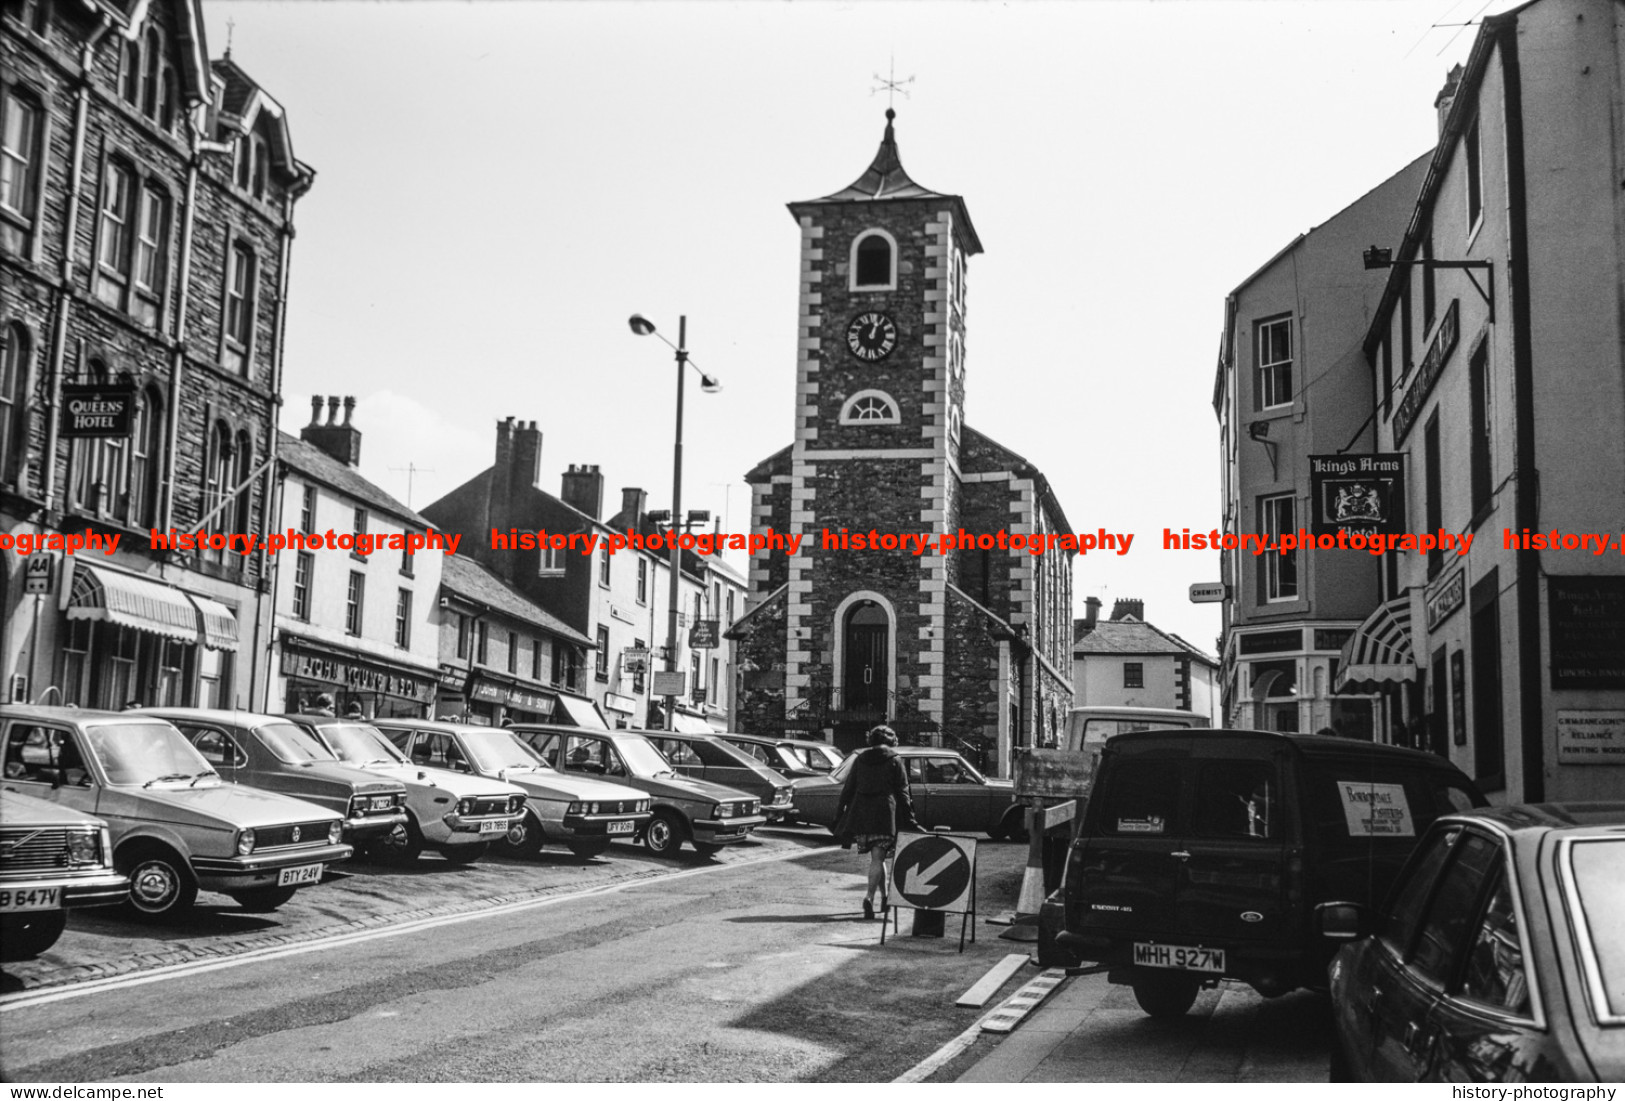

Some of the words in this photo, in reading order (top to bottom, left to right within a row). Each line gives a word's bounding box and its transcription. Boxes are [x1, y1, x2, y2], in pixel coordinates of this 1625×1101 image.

[69, 400, 124, 415] QUEENS
[74, 416, 115, 429] HOTEL
[1360, 458, 1399, 472] Arms
[29, 558, 48, 573] AA
[1192, 588, 1223, 597] CHEMIST
[303, 657, 339, 681] JOHN
[344, 665, 385, 691] YOUNG
[397, 677, 419, 698] SON
[1571, 732, 1613, 740] RELIANCE
[1563, 746, 1599, 754] PRINTING
[283, 869, 301, 884] BTY
[302, 866, 320, 881] 24V
[15, 888, 57, 906] 647V
[1135, 945, 1170, 966] MHH
[1175, 946, 1224, 970] 927W
